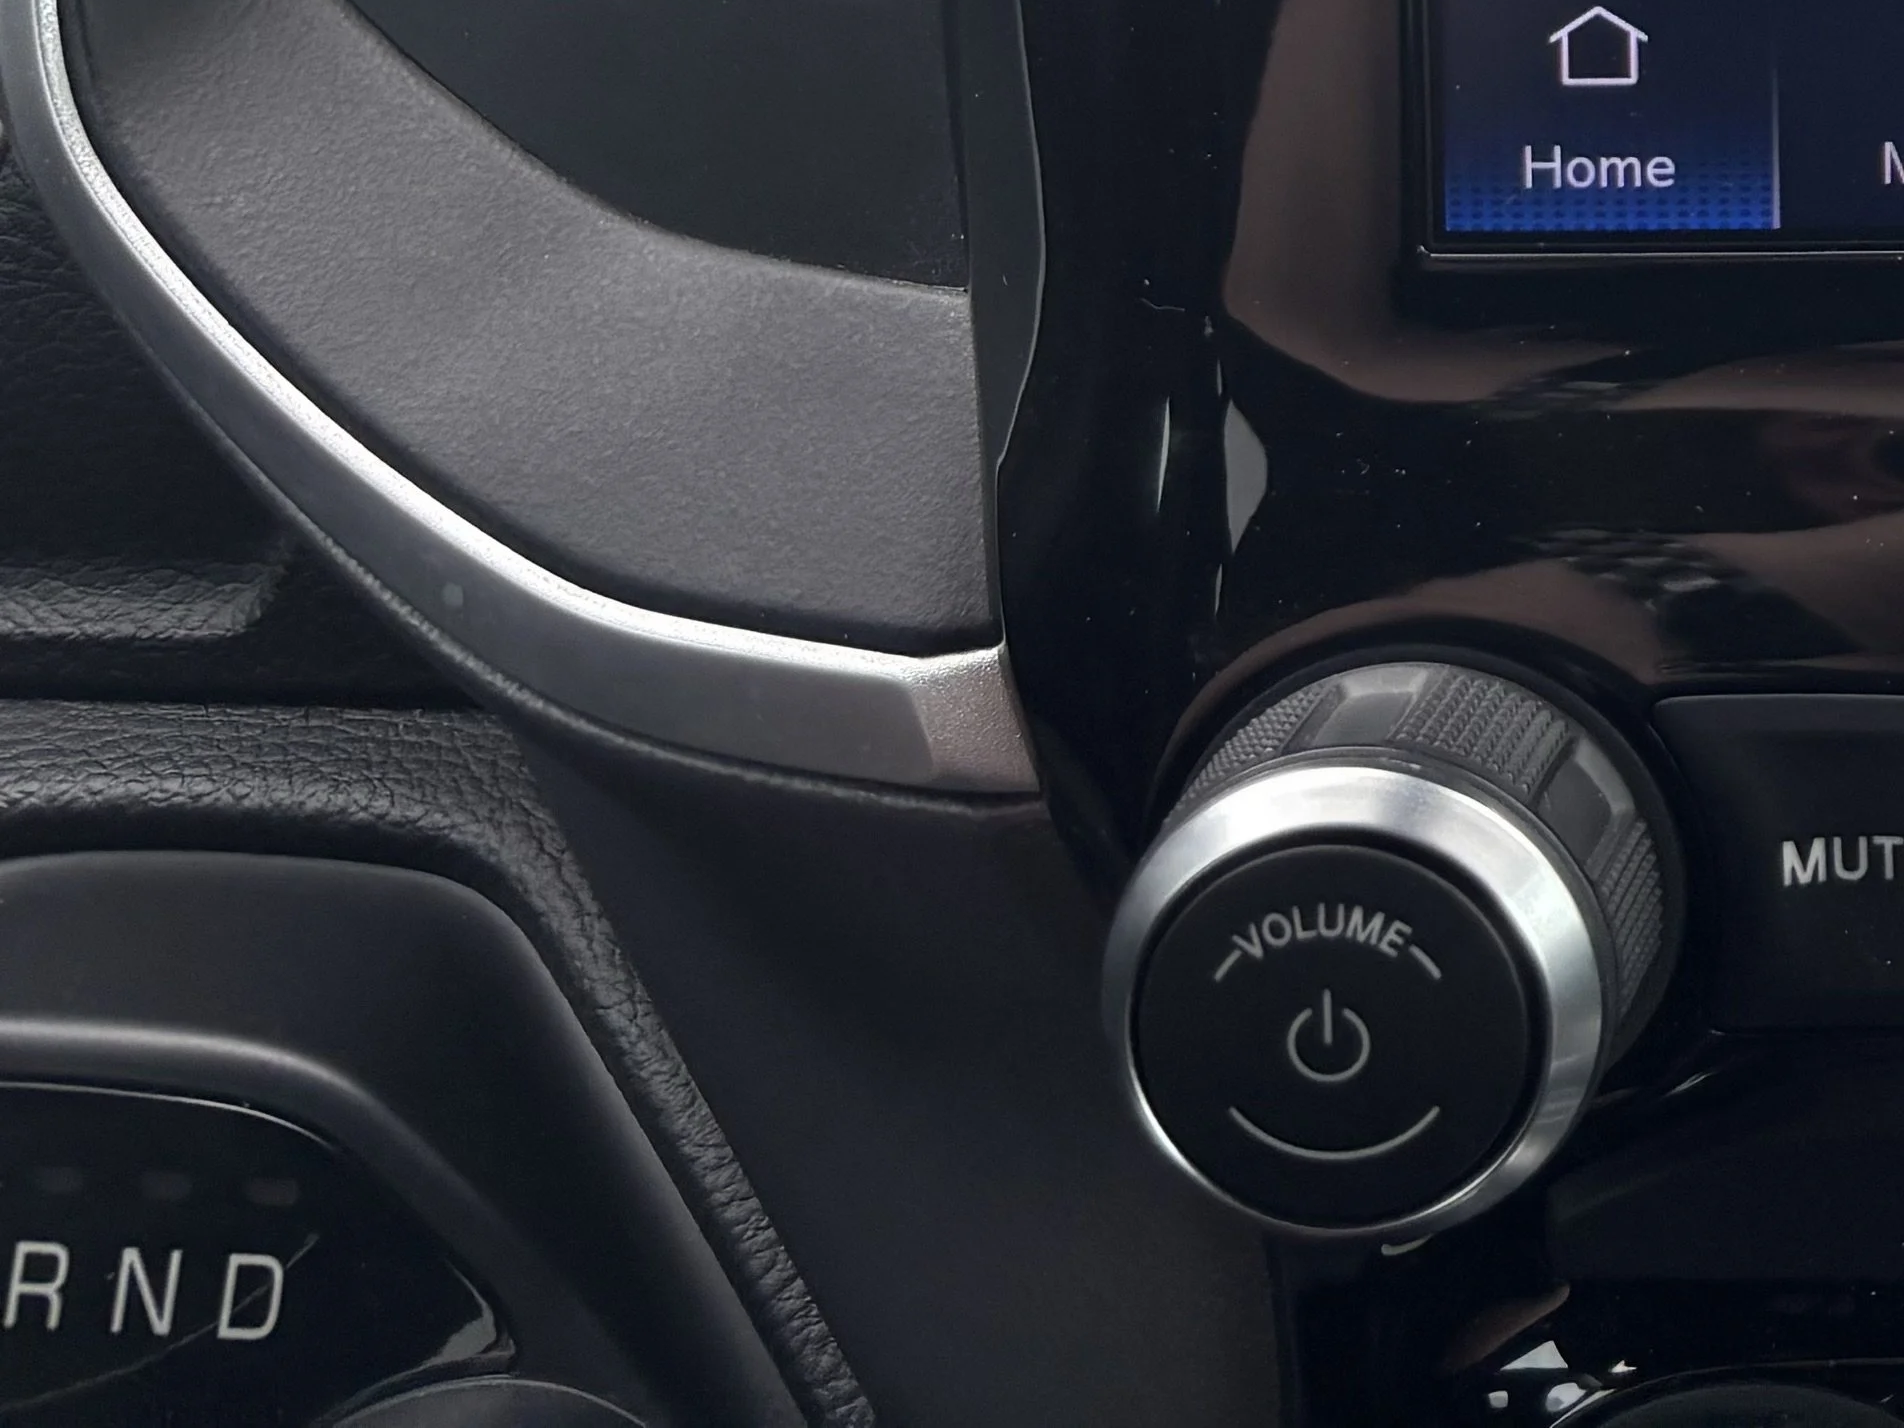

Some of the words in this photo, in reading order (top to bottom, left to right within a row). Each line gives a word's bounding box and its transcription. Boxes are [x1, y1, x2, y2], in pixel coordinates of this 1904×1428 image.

[1524, 144, 1676, 188] Home
[1234, 903, 1413, 958] VOLUME
[4, 1241, 69, 1330] R
[110, 1247, 182, 1336] N
[217, 1253, 285, 1339] D
